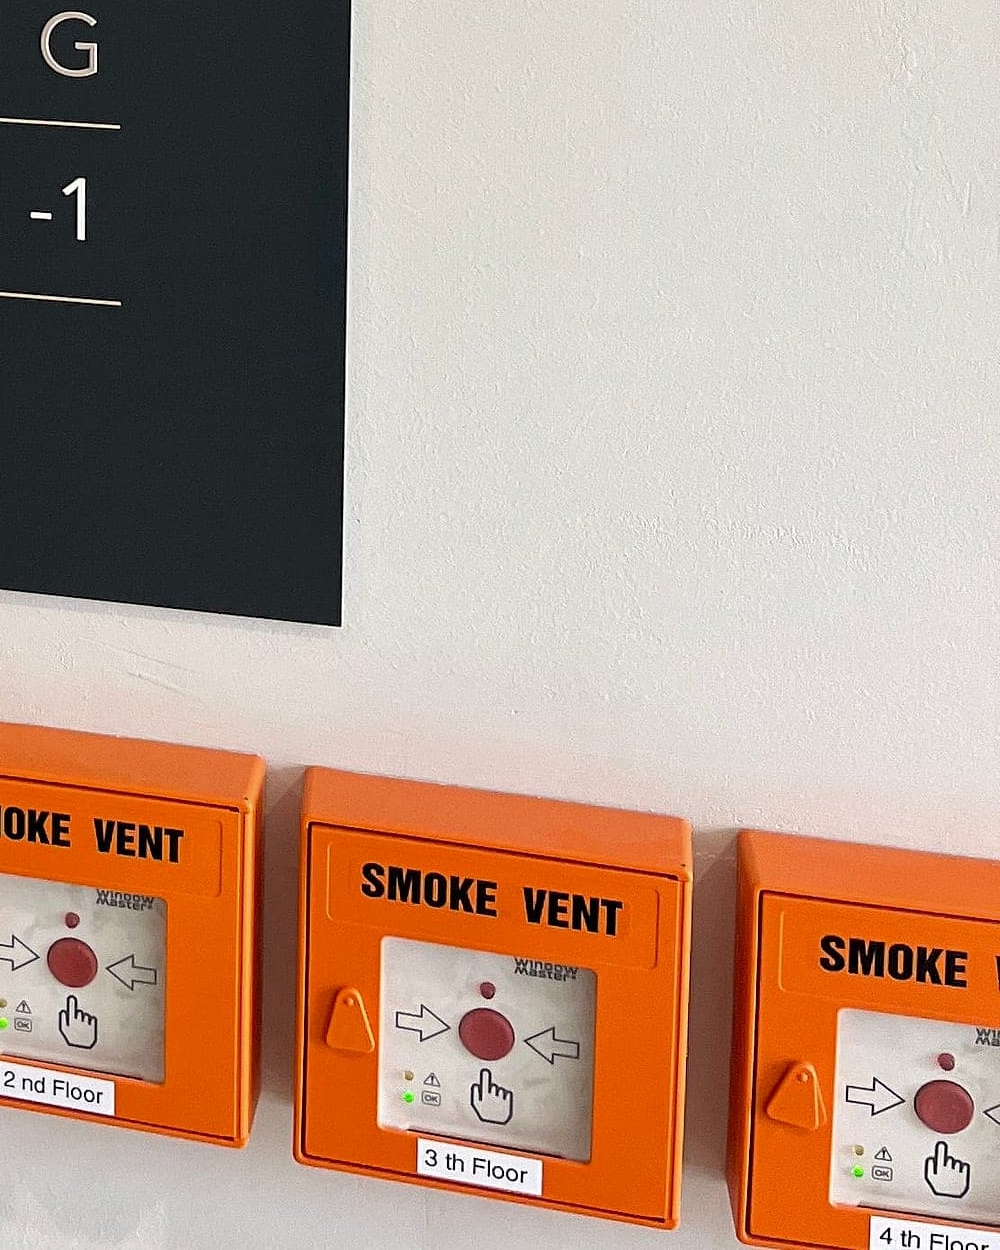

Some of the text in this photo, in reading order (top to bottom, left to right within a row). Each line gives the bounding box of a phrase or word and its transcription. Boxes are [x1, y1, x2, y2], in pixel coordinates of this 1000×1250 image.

[40, 11, 98, 78] G
[29, 177, 86, 241] -1
[93, 818, 184, 863] VENT
[361, 863, 623, 937] SMOKE VENT
[820, 935, 968, 989] SMOKE
[3, 1070, 104, 1104] 2 nd Floor
[424, 1148, 529, 1183] 3 th Floor
[879, 1227, 893, 1245] 4
[900, 1230, 921, 1249] th
